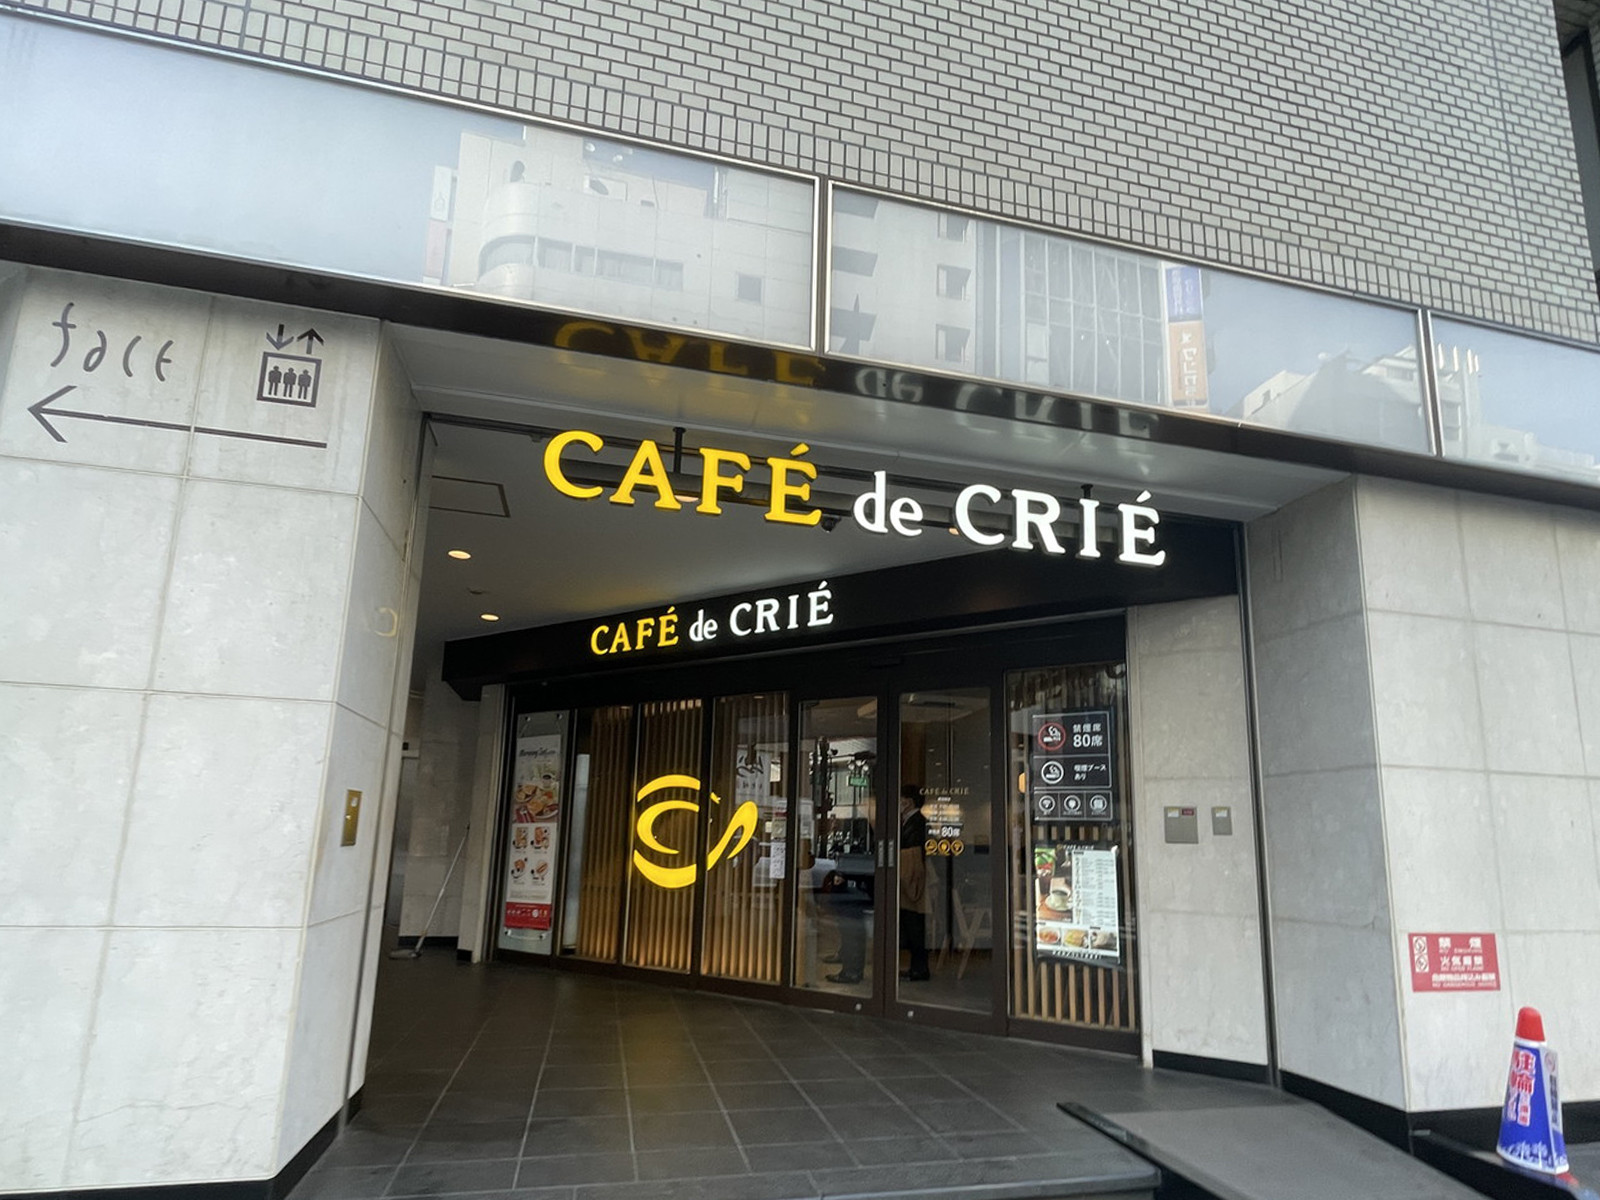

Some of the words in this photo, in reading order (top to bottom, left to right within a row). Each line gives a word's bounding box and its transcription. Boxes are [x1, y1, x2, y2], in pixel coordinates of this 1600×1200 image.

[543, 430, 822, 526] CAFÉ
[853, 470, 924, 537] de
[953, 484, 1166, 566] CRIÉ
[590, 606, 679, 655] CAFÉ
[689, 609, 718, 642] de
[729, 580, 834, 636] CRIÉ
